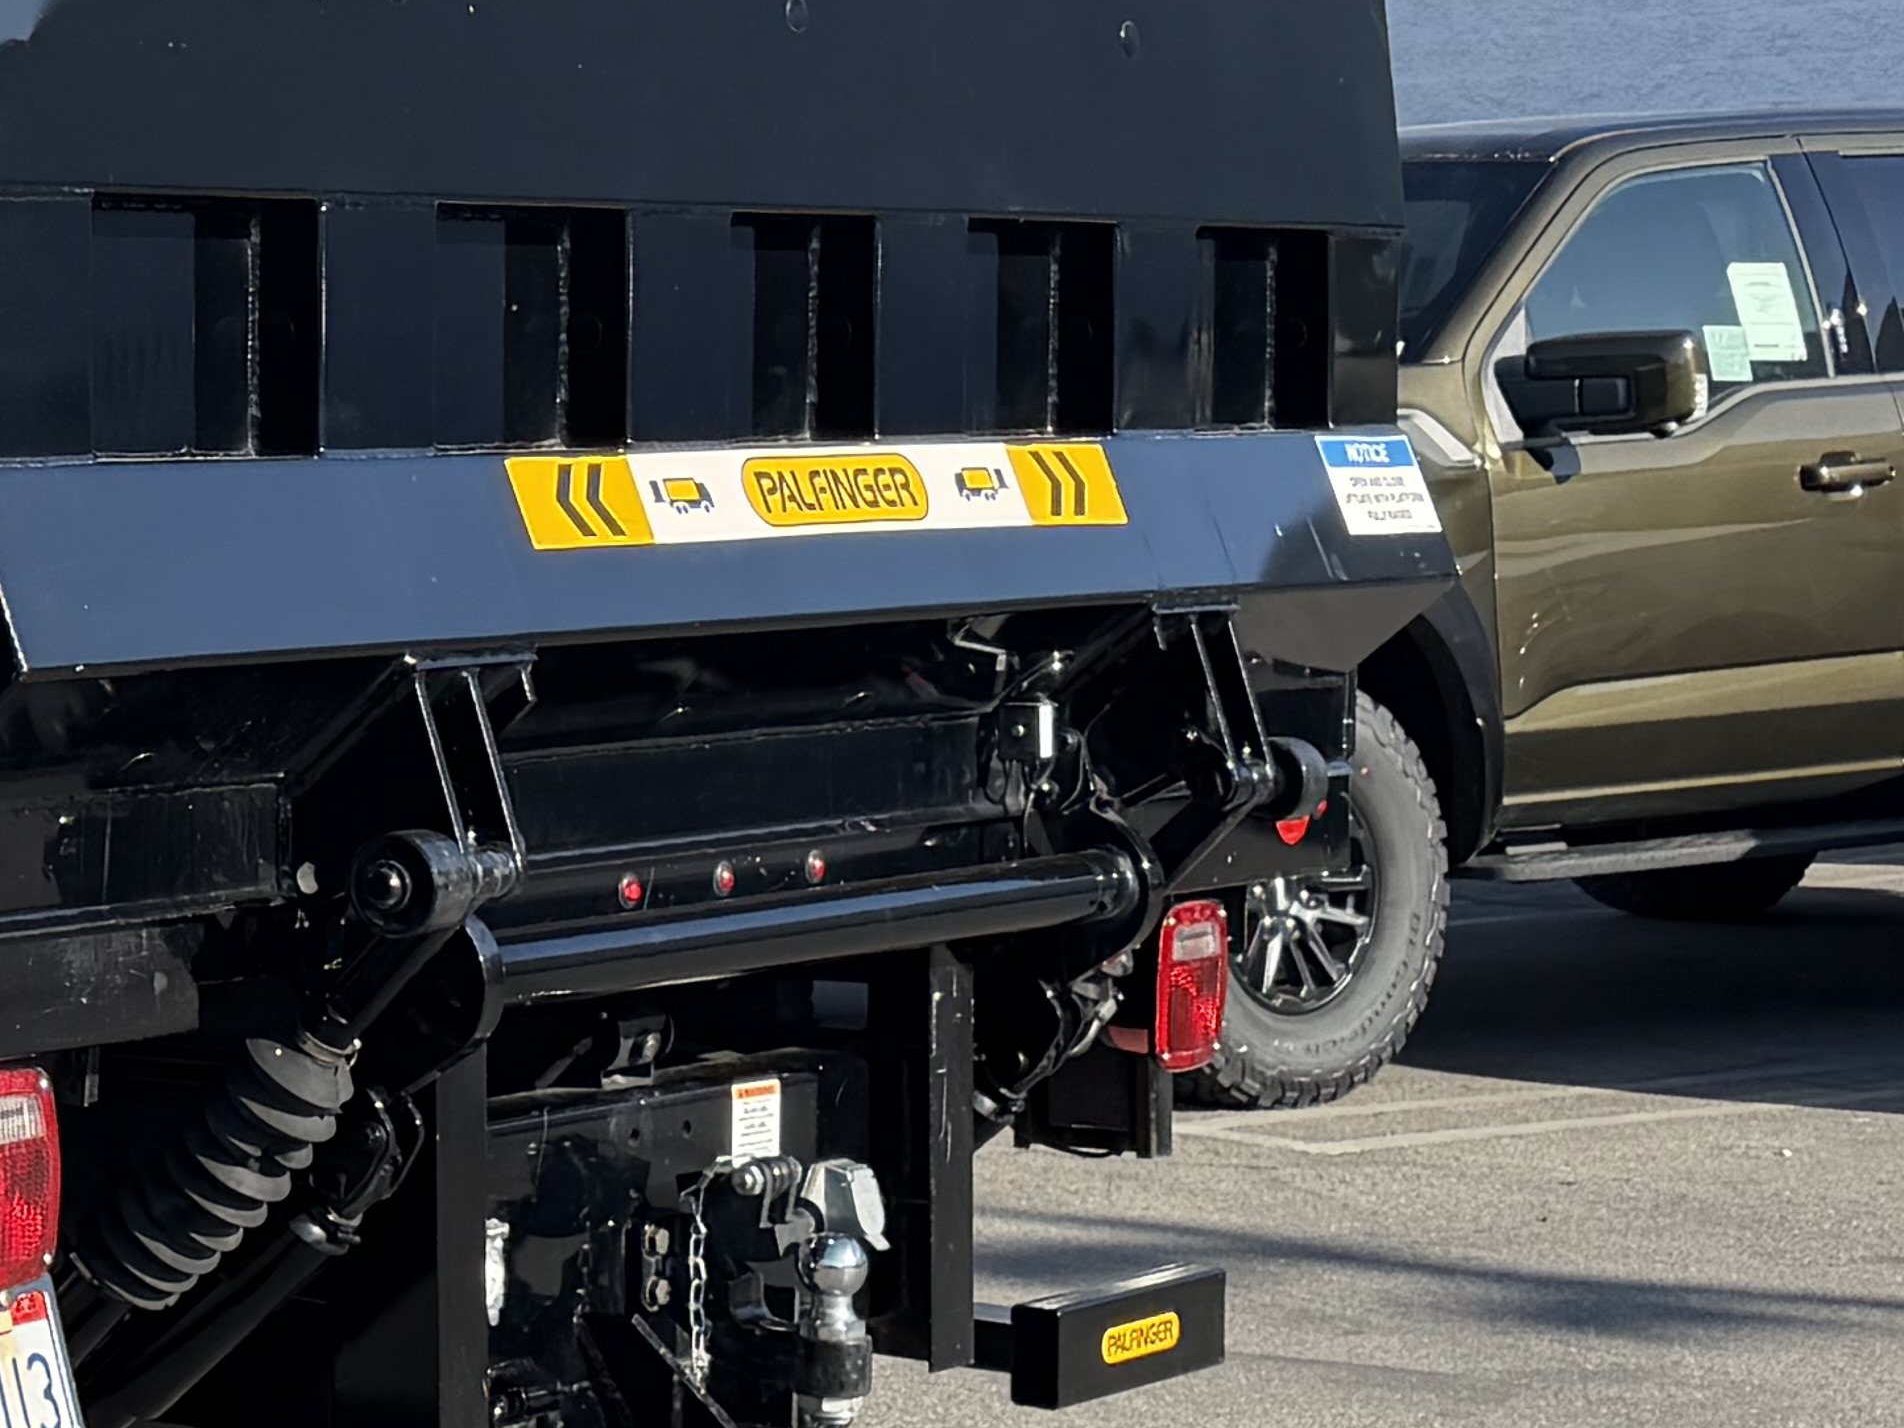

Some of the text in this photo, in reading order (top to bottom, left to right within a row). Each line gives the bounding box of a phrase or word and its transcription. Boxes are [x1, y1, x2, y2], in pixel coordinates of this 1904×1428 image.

[1344, 443, 1391, 463] NOTICE
[753, 466, 918, 514] PALFINGER
[1106, 1320, 1174, 1357] PALFINGER
